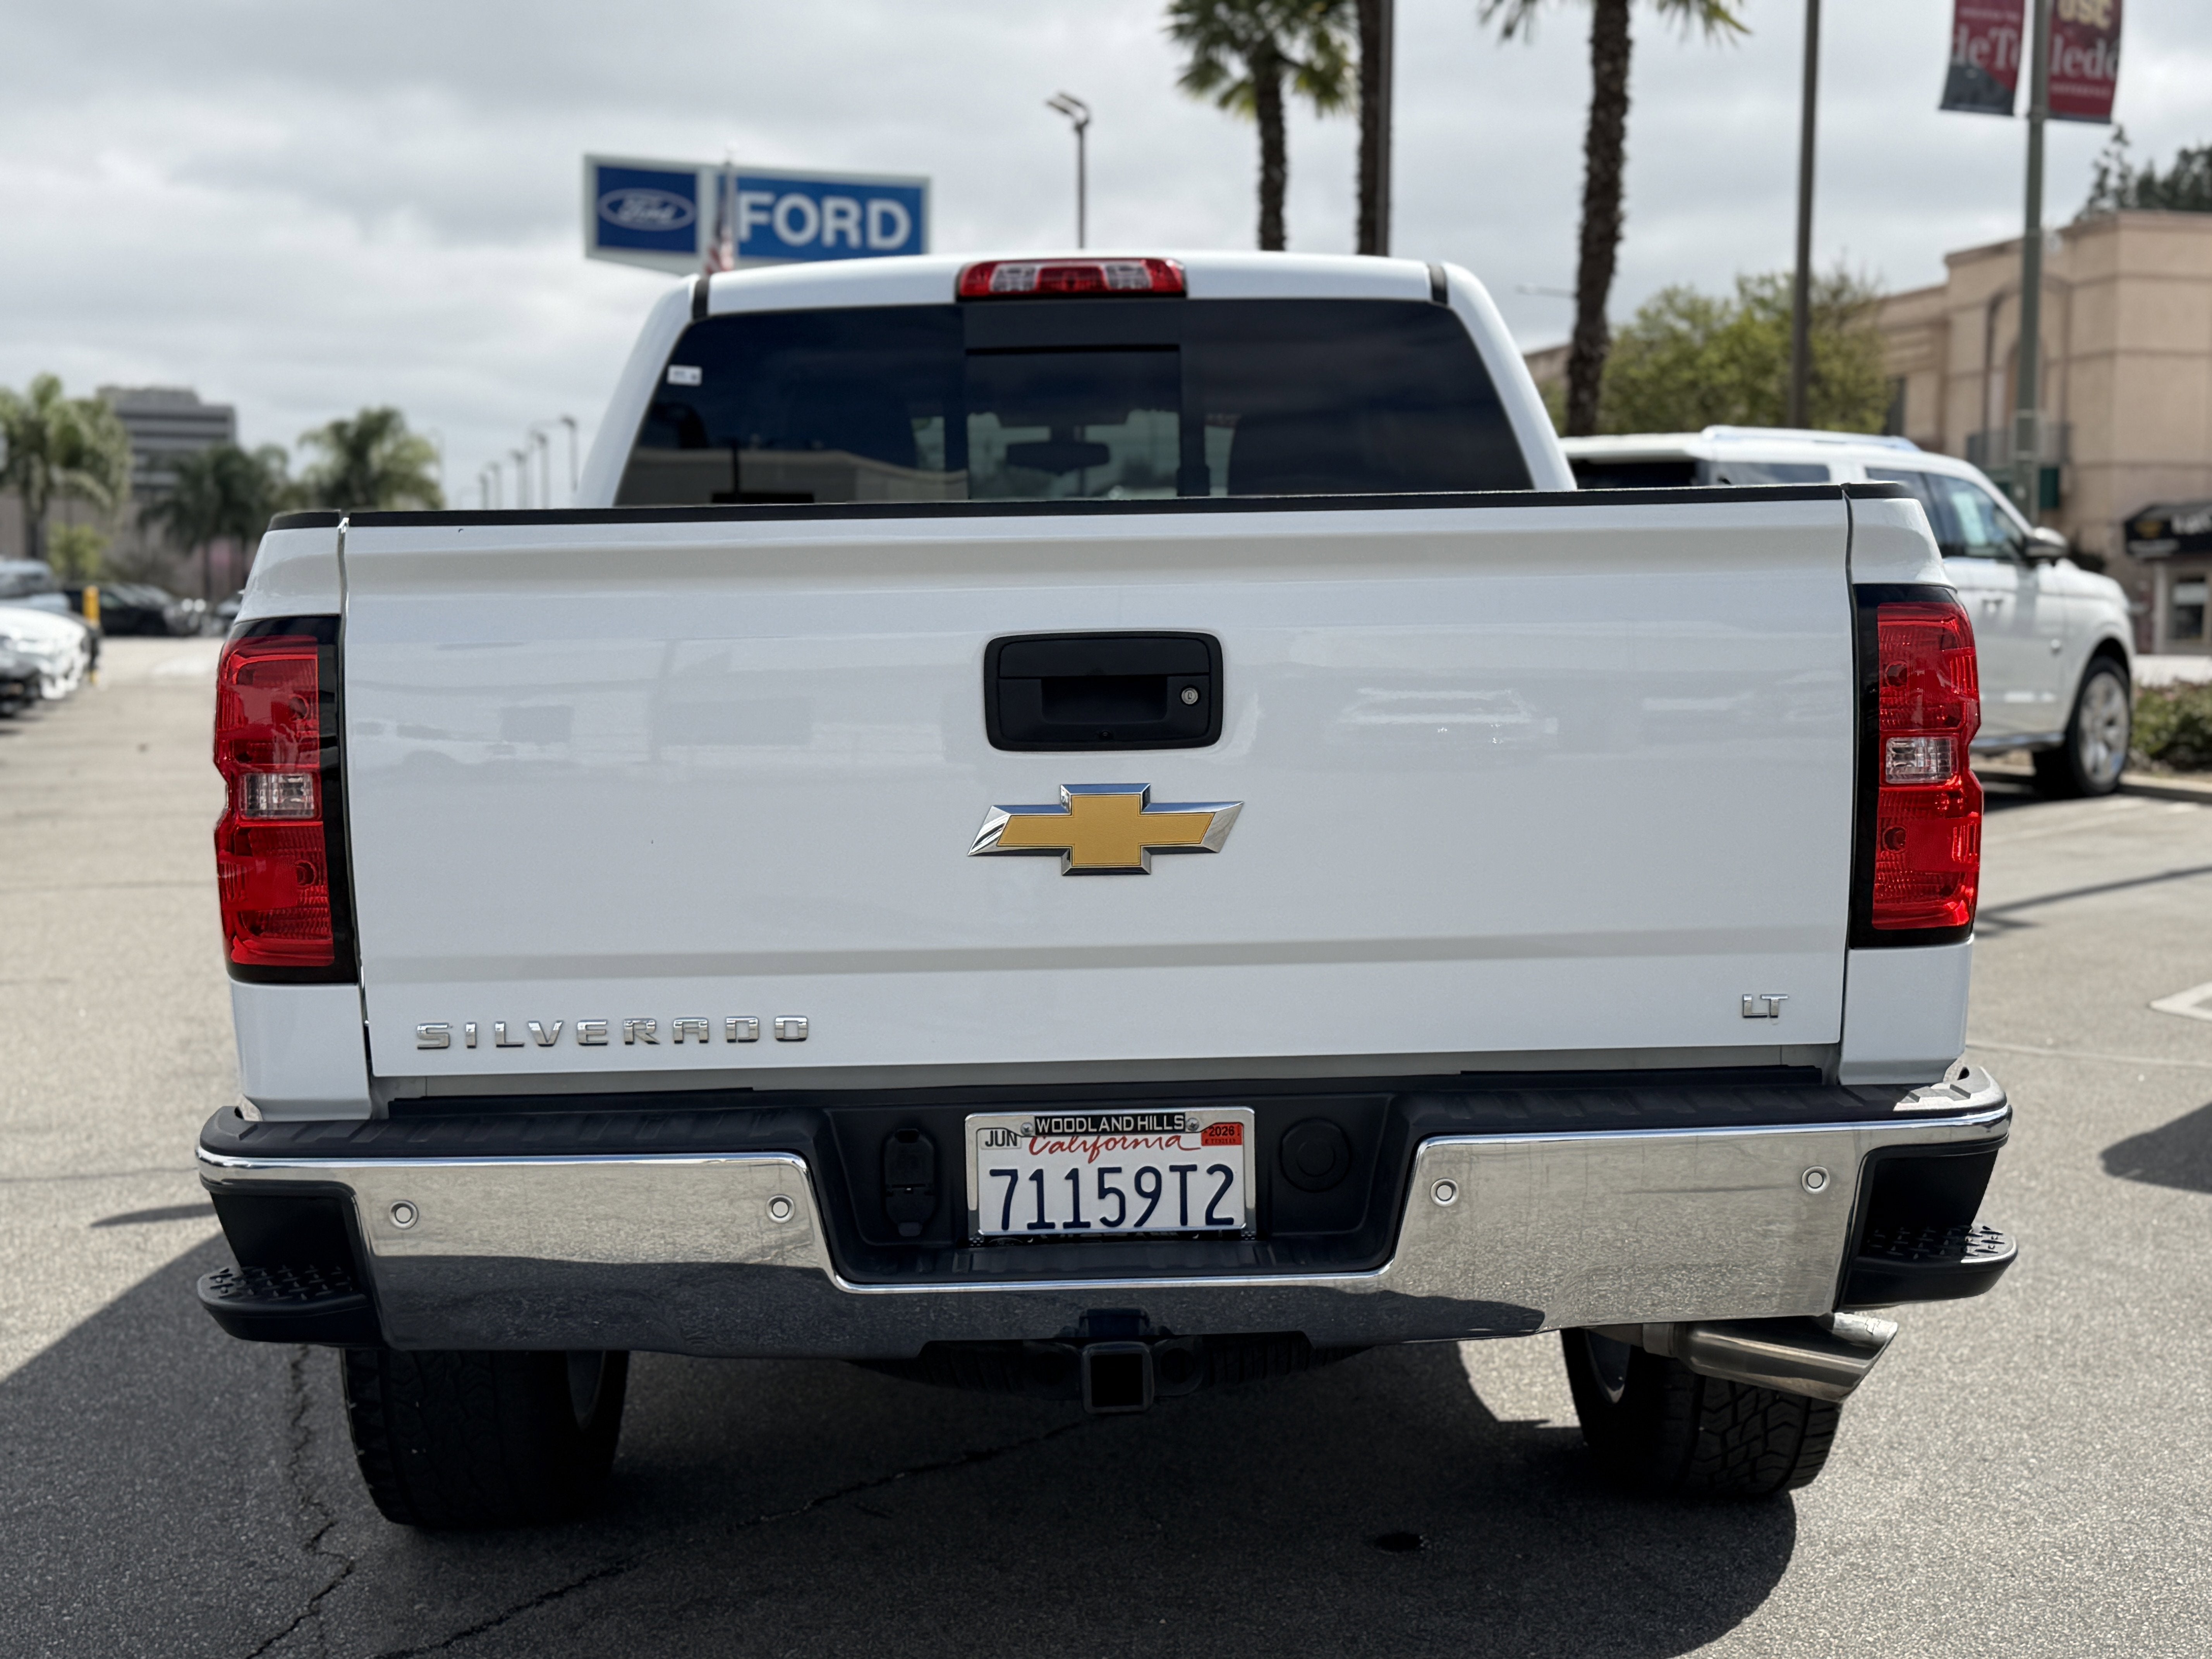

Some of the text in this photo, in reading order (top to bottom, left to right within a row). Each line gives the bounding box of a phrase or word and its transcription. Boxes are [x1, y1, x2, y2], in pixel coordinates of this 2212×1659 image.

[738, 191, 912, 250] FORD
[1742, 994, 1788, 1018] LT
[416, 1015, 809, 1050] SILVERADO
[1036, 1115, 1184, 1133] WOODLAND HILLS
[1208, 1125, 1235, 1137] 2026
[985, 1130, 1017, 1147] JUN
[1029, 1135, 1201, 1164] California
[989, 1163, 1235, 1230] 71159T2
